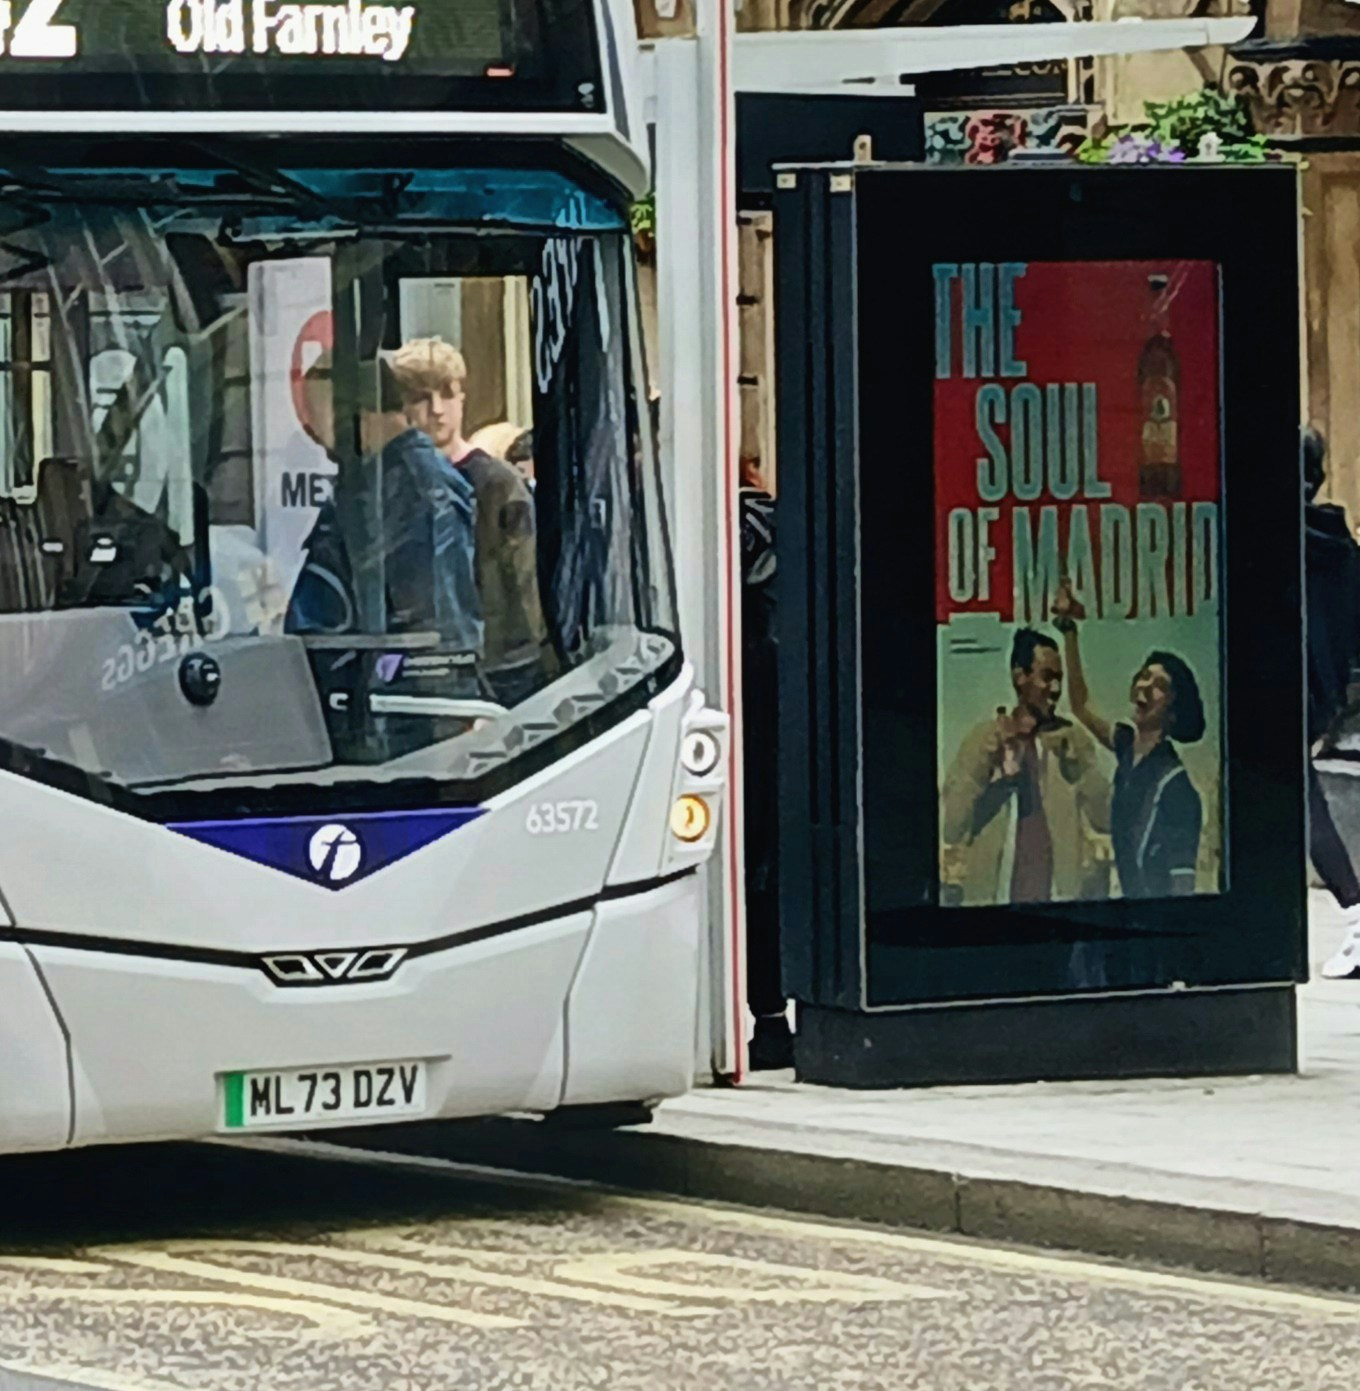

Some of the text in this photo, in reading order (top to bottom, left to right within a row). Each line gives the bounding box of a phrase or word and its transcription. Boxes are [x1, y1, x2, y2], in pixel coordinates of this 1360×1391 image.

[932, 261, 1028, 379] THE
[975, 383, 1112, 500] SOUL
[947, 502, 1219, 626] OF MADRID
[526, 798, 600, 835] 63572
[249, 1063, 419, 1118] ML73 DZV
